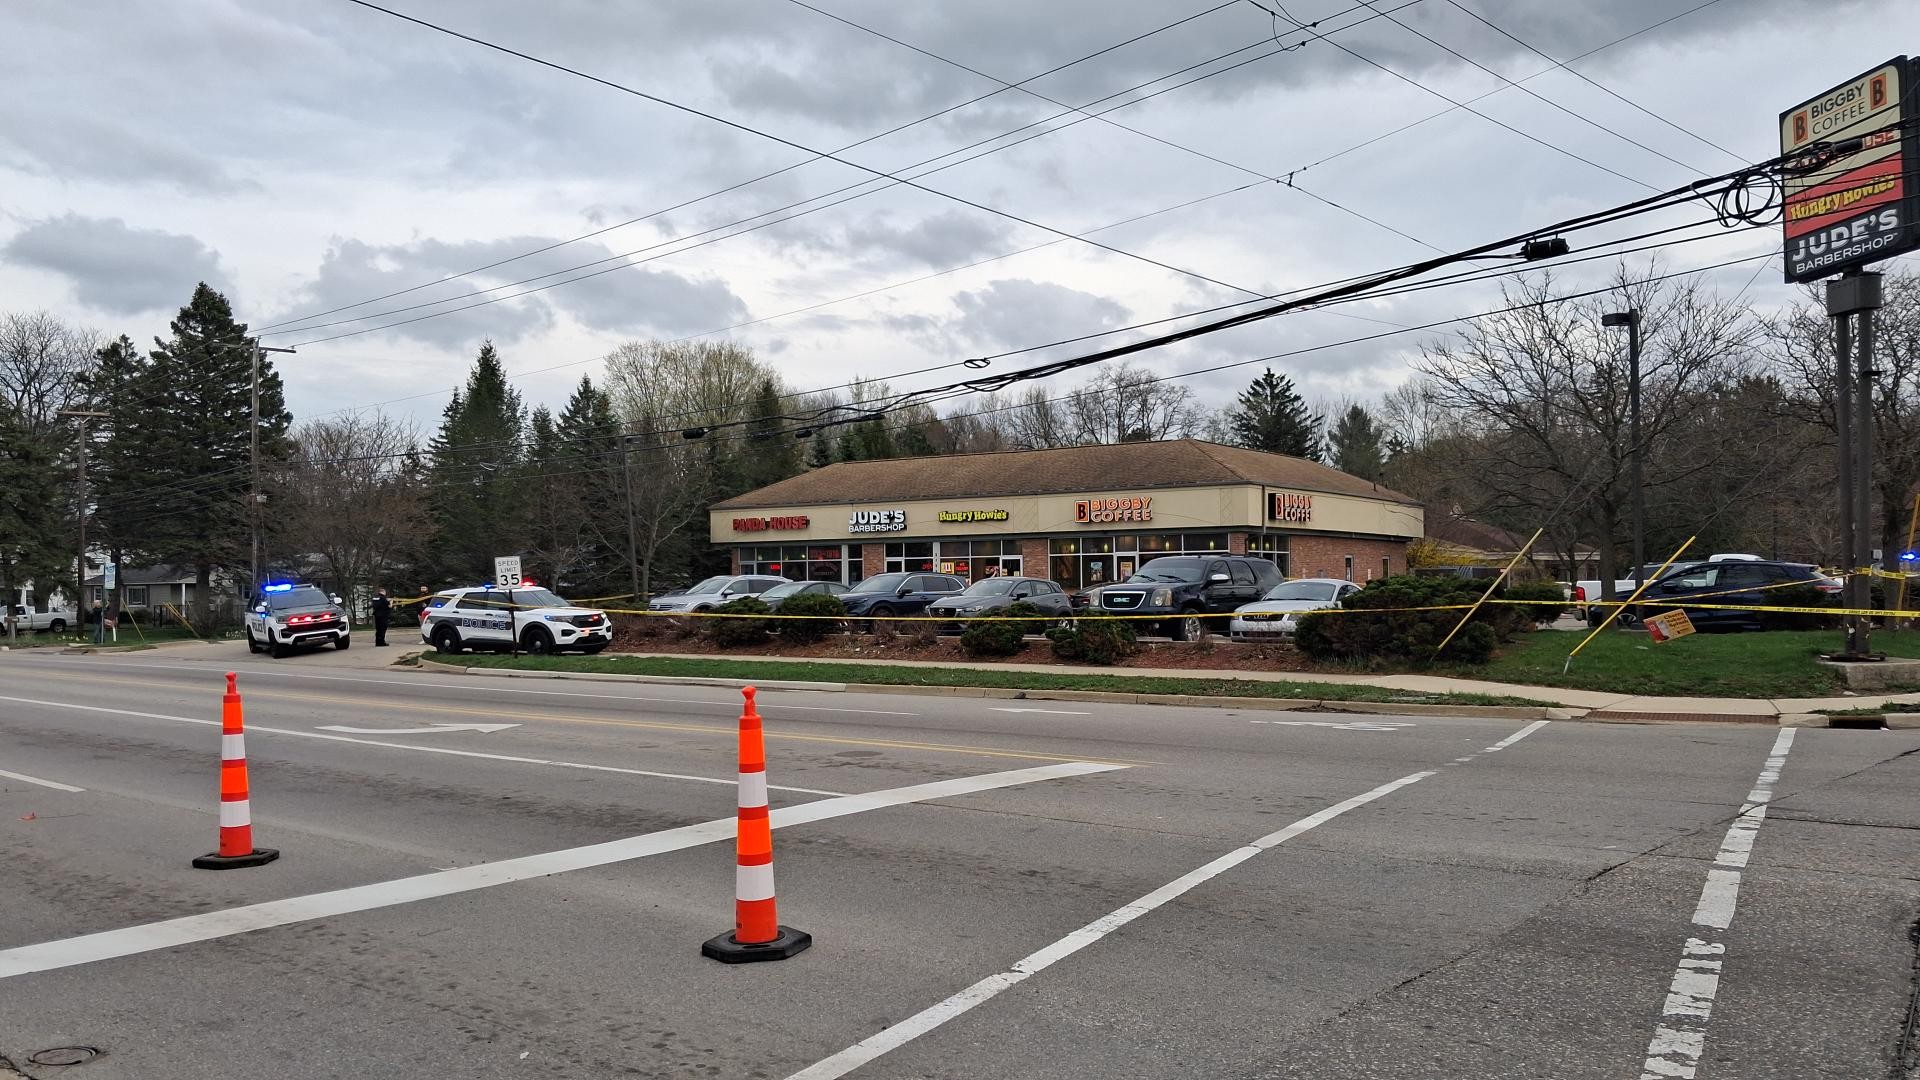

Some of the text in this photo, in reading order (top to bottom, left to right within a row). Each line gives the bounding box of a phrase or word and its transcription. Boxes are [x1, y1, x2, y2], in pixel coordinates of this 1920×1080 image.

[1811, 83, 1865, 119] BIGGBY
[1812, 101, 1866, 134] COFFEE
[1790, 193, 1840, 220] Hungry
[1792, 209, 1898, 261] JUDE'S
[1796, 233, 1894, 273] BARBERSHOP
[1090, 497, 1152, 511] BIGGBY
[733, 515, 808, 532] PANDA HOUSE
[849, 510, 905, 525] JUDE'S
[939, 511, 973, 522] Hungry
[1090, 510, 1153, 522] COFFEE
[848, 523, 906, 533] BARBERSHOP
[500, 574, 520, 586] 35
[462, 618, 506, 631] POLICE
